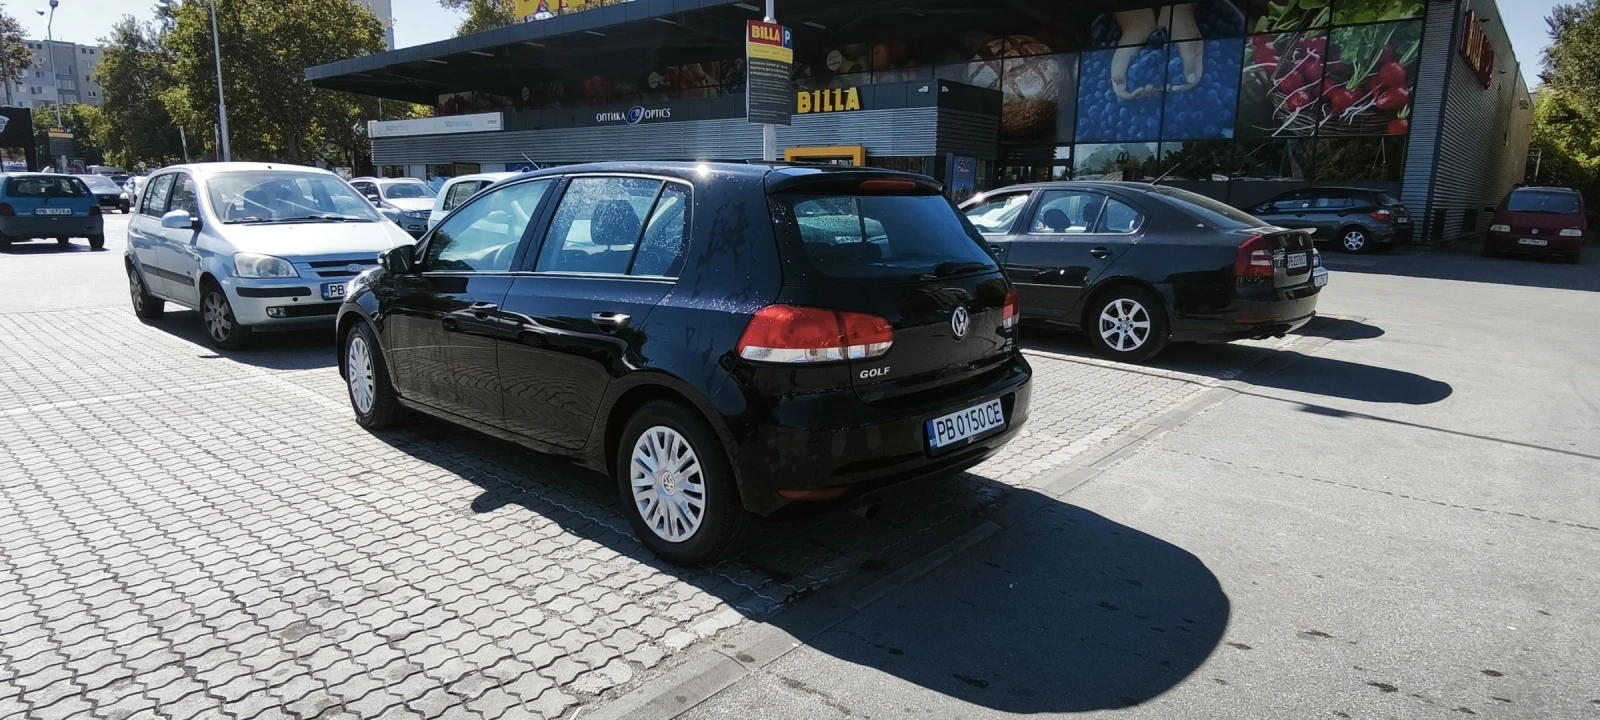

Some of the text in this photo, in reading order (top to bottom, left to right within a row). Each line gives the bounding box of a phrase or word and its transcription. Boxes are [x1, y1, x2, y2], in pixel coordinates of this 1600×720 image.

[751, 25, 791, 45] BILLA P
[797, 87, 860, 114] BILLA
[596, 112, 626, 122] ОПТИКА
[645, 108, 671, 119] OPTICS
[958, 160, 971, 171] 500
[329, 284, 345, 296] PB
[860, 366, 891, 379] GOLF
[936, 402, 1002, 443] PB 0150 CE
